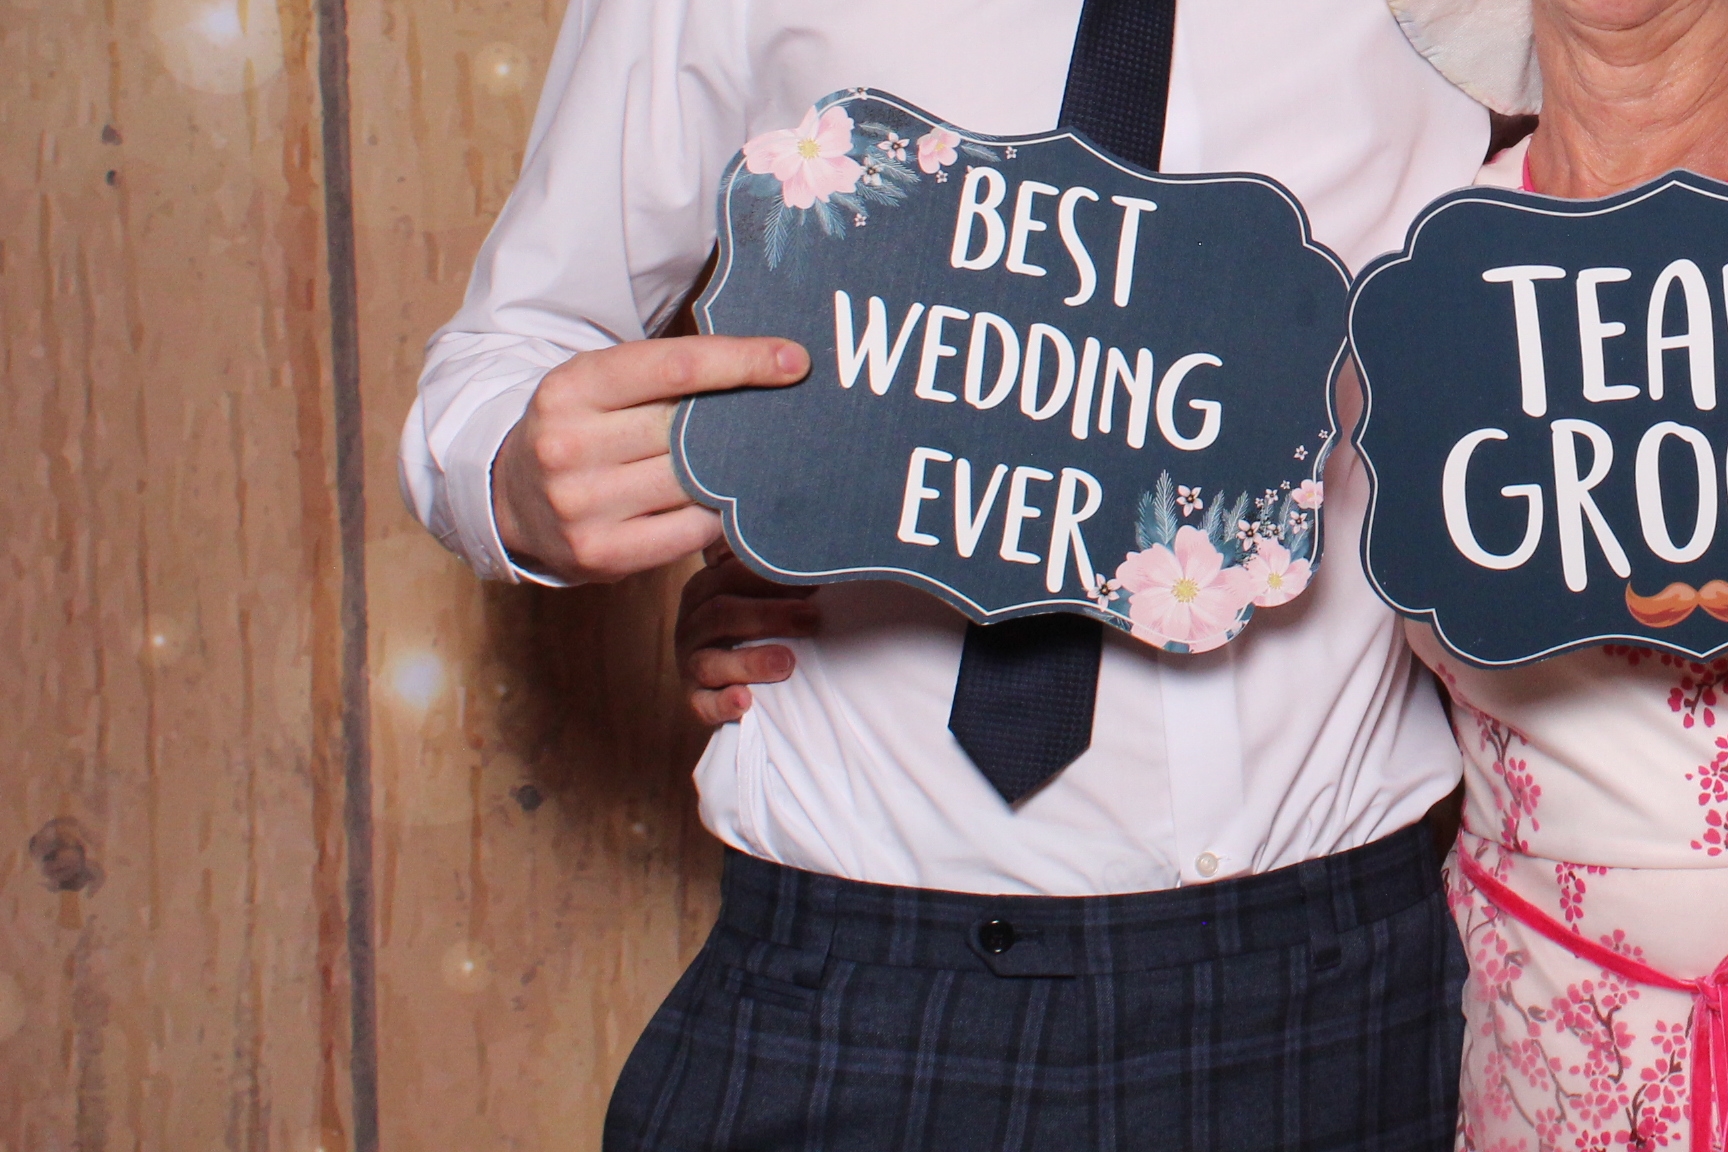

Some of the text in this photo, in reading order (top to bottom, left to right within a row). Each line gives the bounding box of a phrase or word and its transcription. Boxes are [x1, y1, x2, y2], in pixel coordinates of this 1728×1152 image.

[951, 166, 1157, 307] BEST
[835, 290, 1223, 451] WEDDING
[898, 447, 1102, 593] EVER
